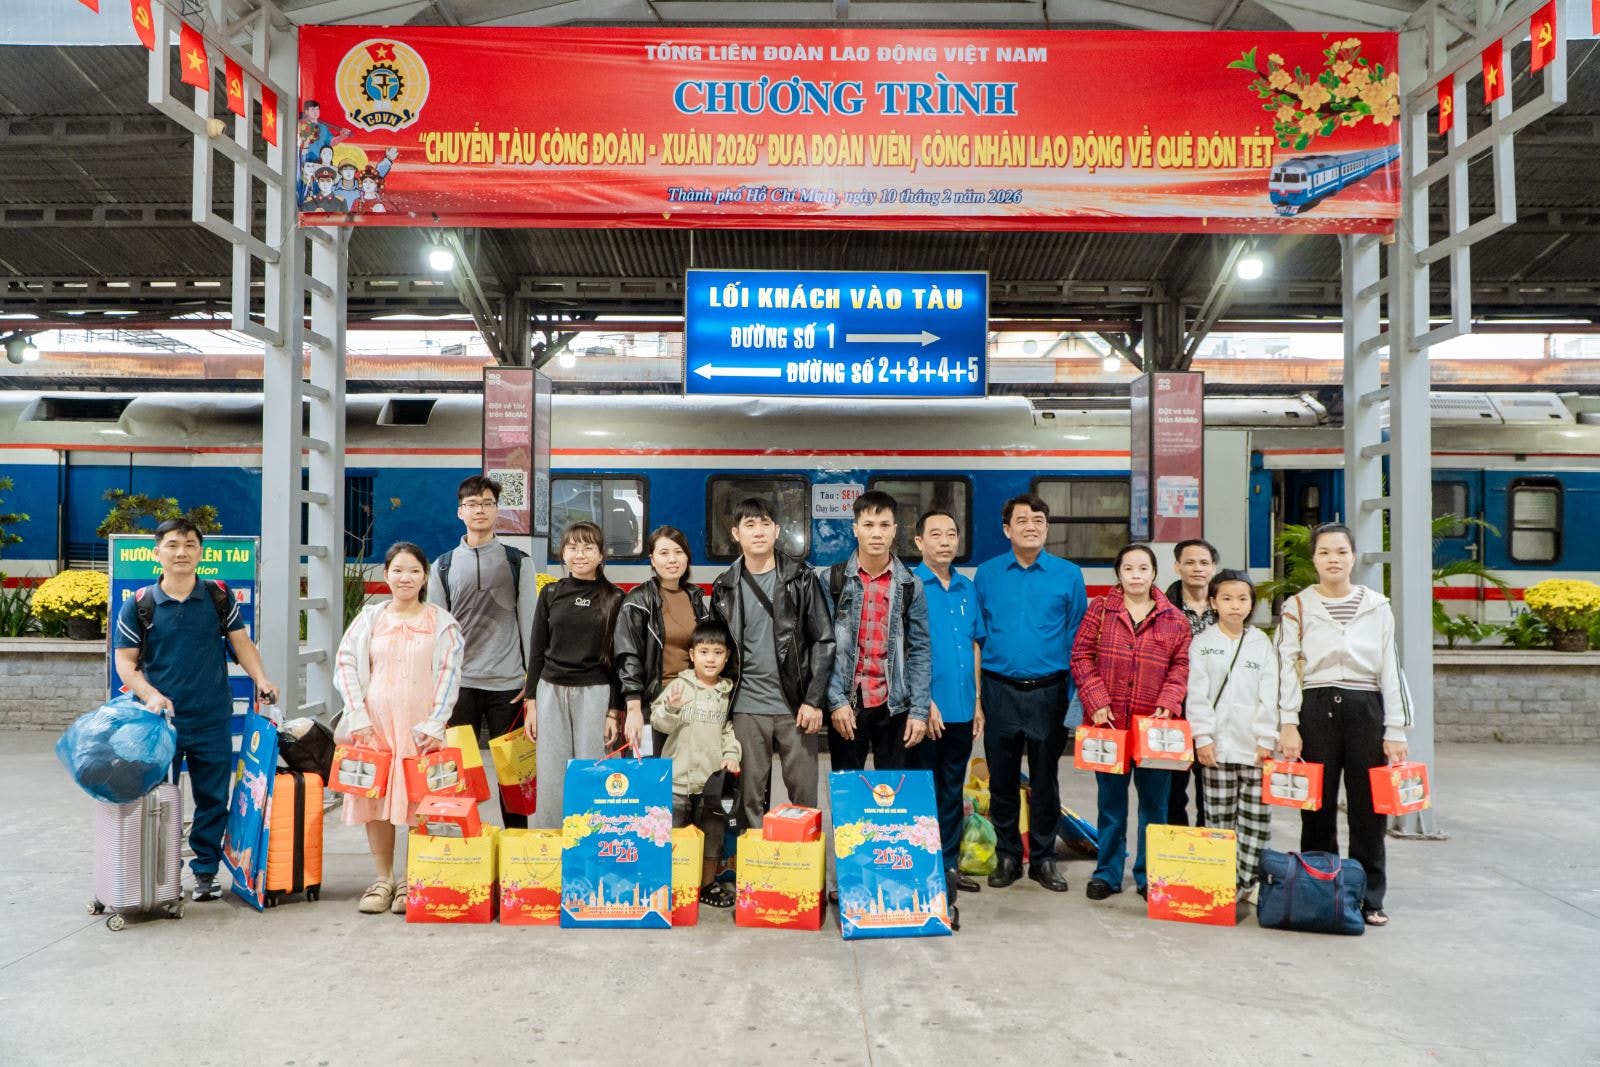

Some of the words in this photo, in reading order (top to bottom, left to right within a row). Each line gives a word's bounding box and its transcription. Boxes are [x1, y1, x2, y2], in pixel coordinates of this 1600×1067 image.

[644, 40, 702, 61] TỔNG
[709, 44, 757, 61] LIÊN
[763, 43, 824, 62] ĐOÀN
[830, 47, 870, 62] LAO
[877, 44, 937, 65] ĐỘNG
[943, 44, 990, 65] VIỆT
[996, 47, 1047, 62] NAM
[673, 75, 867, 116] CHƯƠNG
[875, 71, 1018, 116] TRÌNH
[498, 127, 536, 165] TÀU
[540, 127, 588, 165] CÔNG
[592, 127, 645, 165] ĐOÀN
[661, 128, 712, 166] XUÂN
[768, 133, 808, 166] ĐƯA
[811, 129, 865, 166] ĐOÀN
[868, 129, 917, 173] VIÊN,
[921, 129, 970, 167] CÔNG
[974, 130, 1026, 168] NHÂN
[1030, 135, 1069, 168] LAO
[1072, 130, 1123, 174] ĐỘNG
[1127, 124, 1152, 168] VỀ
[1157, 130, 1193, 169] QUÊ
[1197, 130, 1237, 168] ĐÓN
[1241, 125, 1274, 169] TẾT
[667, 186, 713, 203] Thành
[715, 185, 745, 205] phố
[746, 185, 768, 203] Hồ
[770, 187, 796, 203] Chí
[800, 187, 840, 205] Minh,
[844, 188, 877, 206] ngày
[880, 188, 897, 204] 10
[899, 188, 941, 206] tháng
[941, 188, 952, 204] 2
[954, 188, 986, 204] năm
[987, 188, 1023, 204] 2026
[709, 281, 748, 308] LỐI
[758, 284, 840, 309] KHÁCH
[850, 284, 902, 310] VÀO
[911, 284, 963, 310] TÀU
[730, 322, 788, 349] ĐƯỜNG
[793, 321, 818, 349] SỐ
[826, 323, 835, 349] 1
[786, 358, 845, 384] ĐƯỜNG
[851, 357, 876, 384] SỐ
[878, 356, 979, 383] 2+3+4+5
[120, 547, 158, 562] HƯỚN
[226, 547, 249, 562] TÀU
